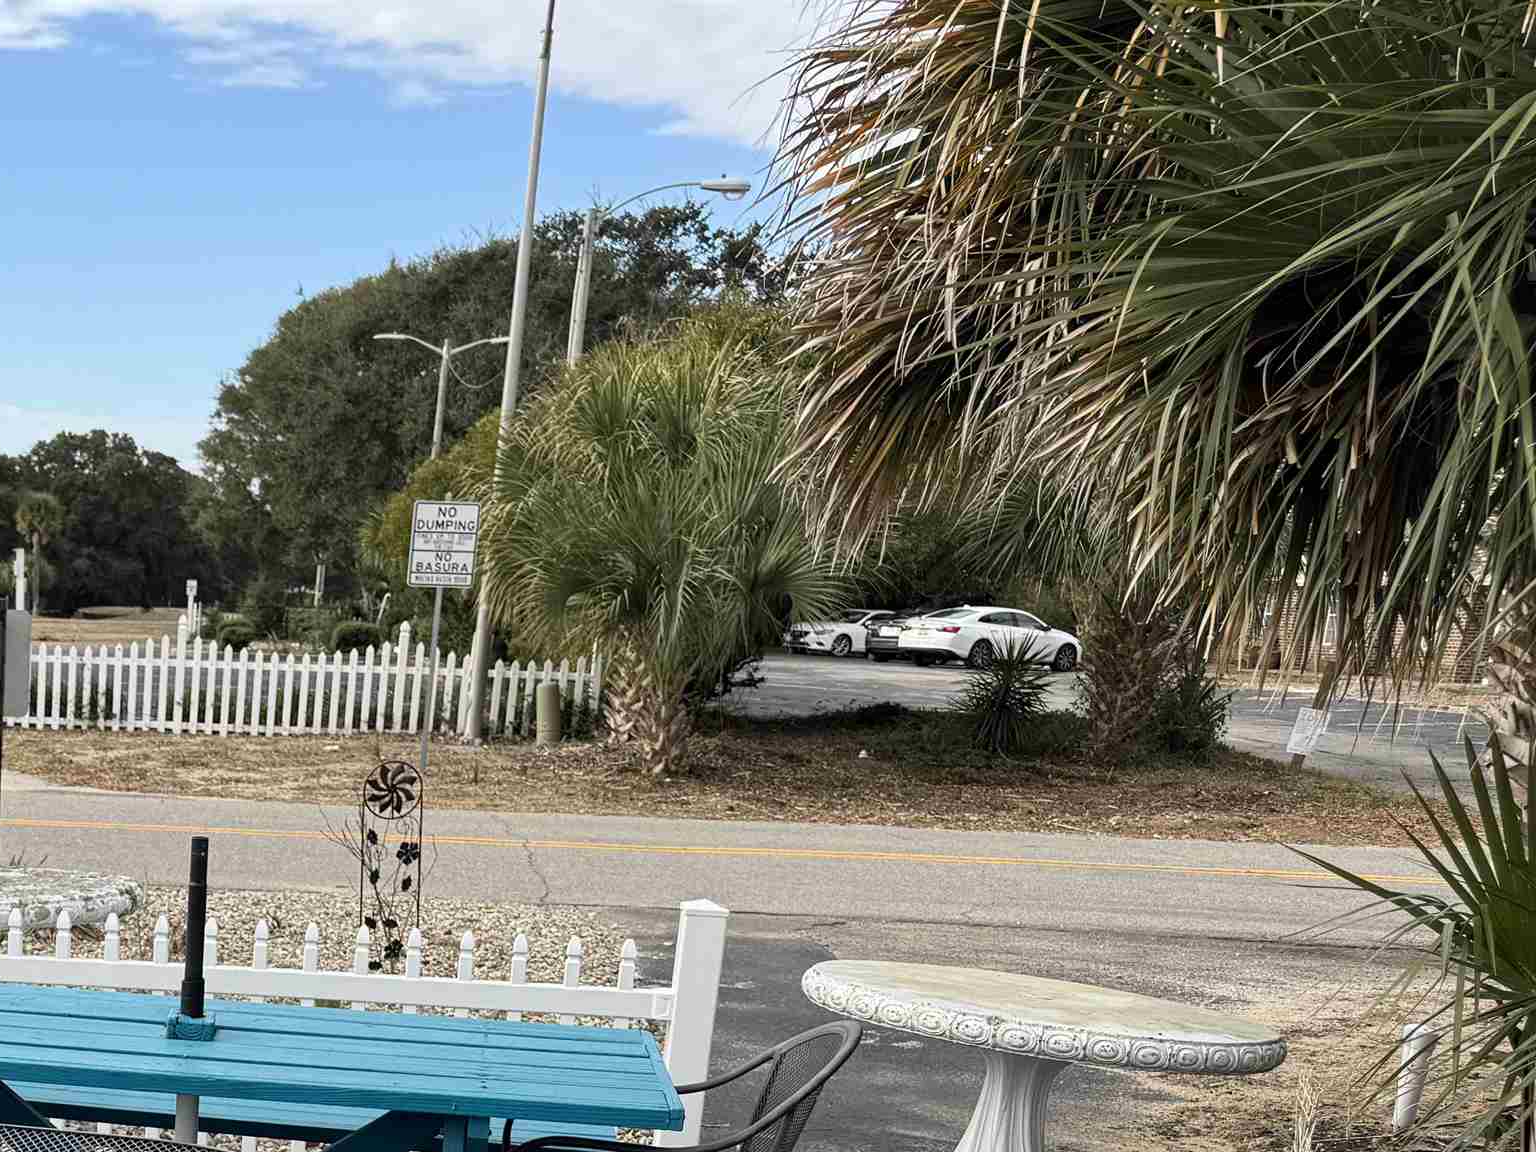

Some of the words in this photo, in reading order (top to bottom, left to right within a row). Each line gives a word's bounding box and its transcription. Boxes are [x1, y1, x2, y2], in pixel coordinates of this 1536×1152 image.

[437, 506, 457, 518] NO
[417, 519, 475, 531] DUMPING
[434, 552, 452, 562] NO
[415, 561, 469, 573] BASURA
